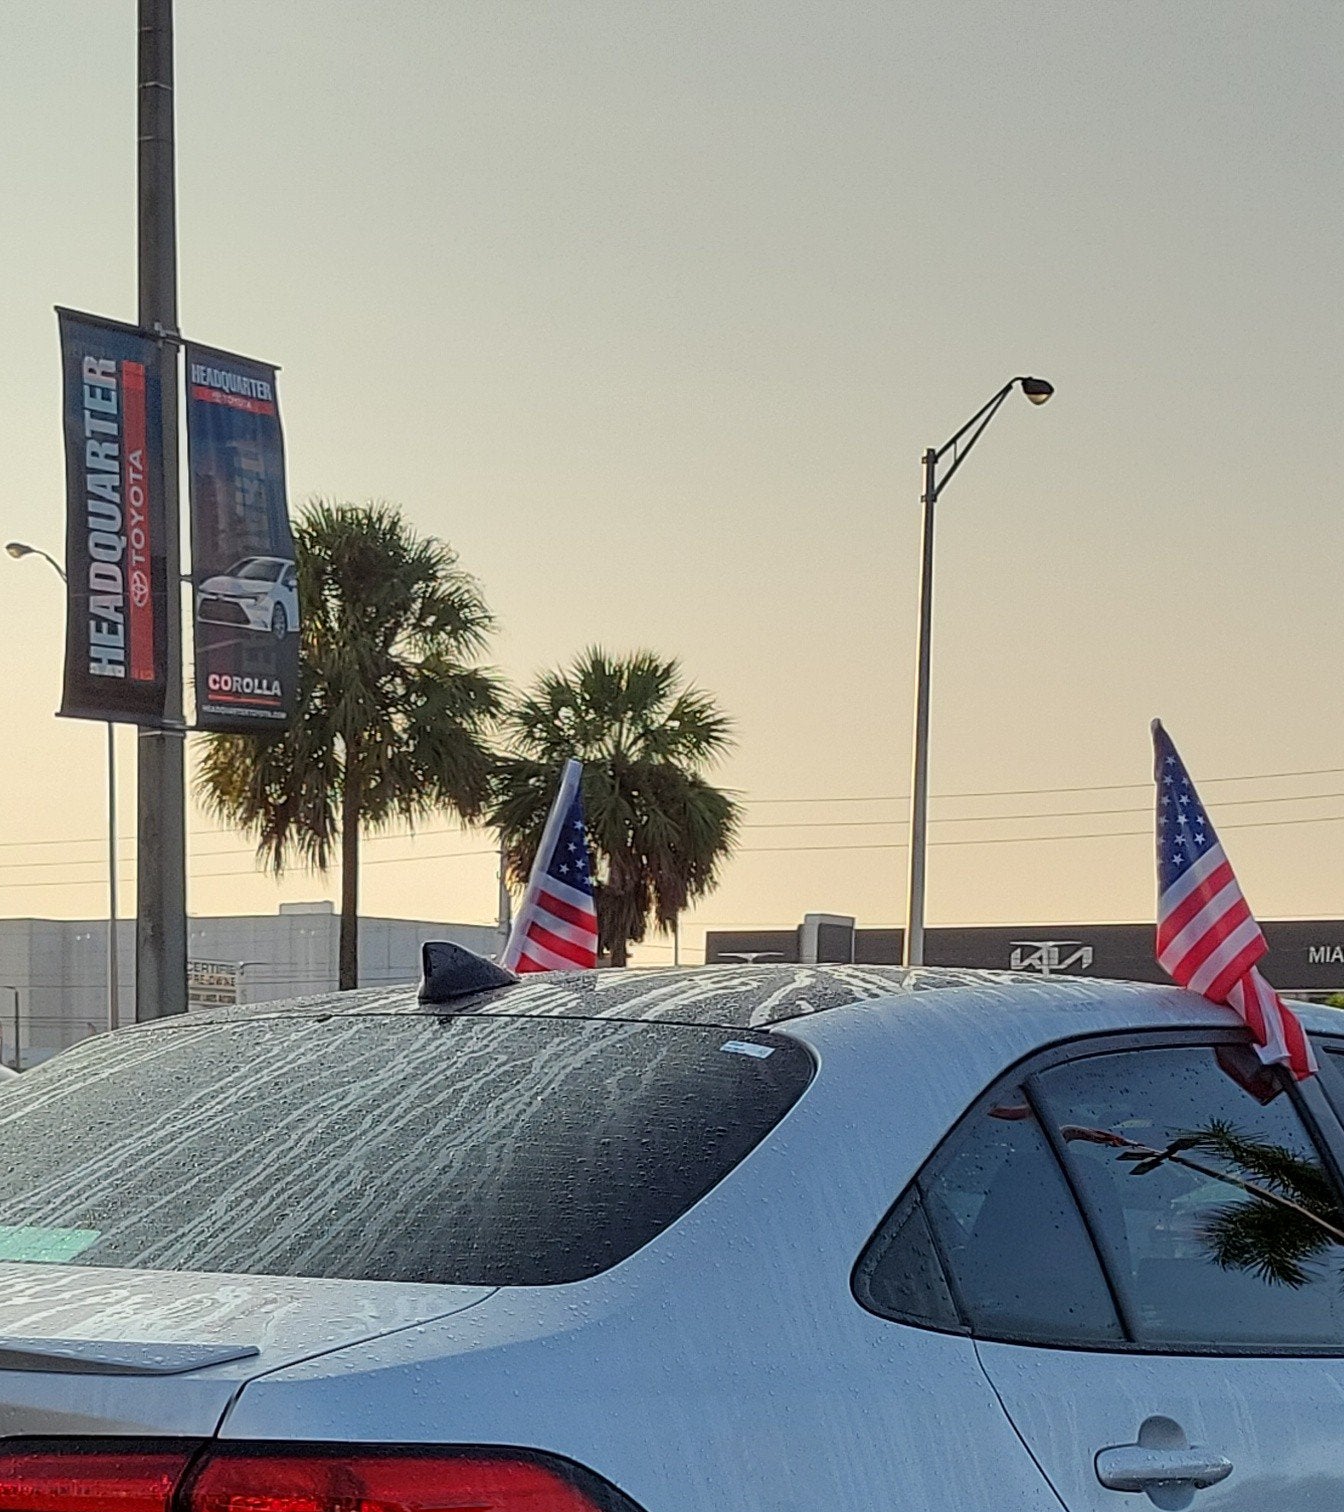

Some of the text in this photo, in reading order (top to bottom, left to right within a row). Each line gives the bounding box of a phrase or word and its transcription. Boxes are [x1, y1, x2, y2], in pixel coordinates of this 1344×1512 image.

[191, 363, 273, 400] HEADQUARTER
[83, 355, 126, 680] HEADQUARTER
[122, 449, 147, 564] TOYOTA
[208, 673, 283, 697] COROLLA
